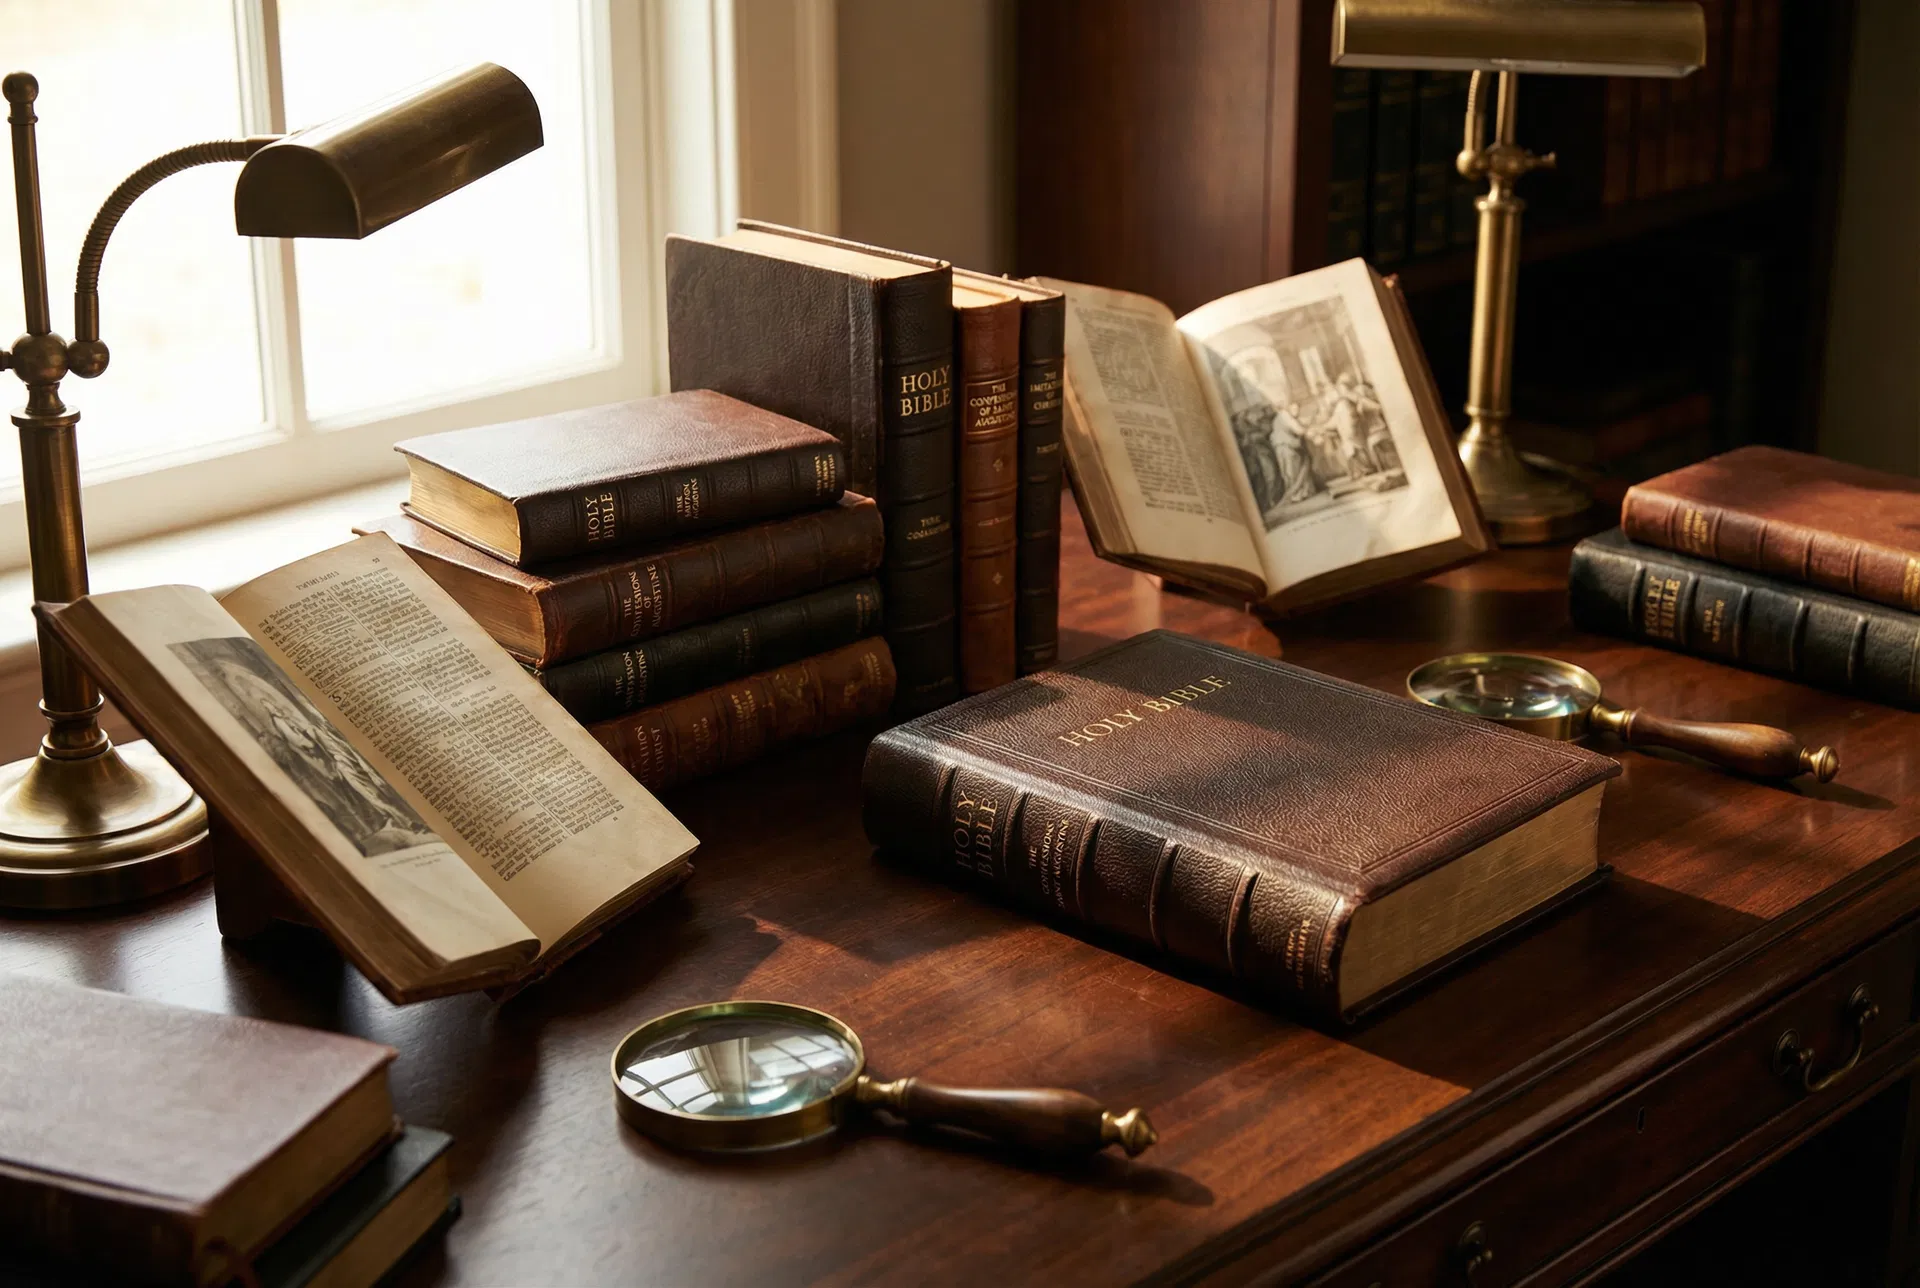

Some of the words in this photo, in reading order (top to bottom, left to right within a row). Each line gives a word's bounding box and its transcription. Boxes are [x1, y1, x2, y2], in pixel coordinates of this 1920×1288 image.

[900, 387, 950, 417] BIBLE
[901, 365, 950, 393] HOLY
[585, 495, 600, 543] HOLY
[600, 492, 616, 540] BIBLE
[623, 597, 632, 618] THE
[643, 595, 652, 609] OF
[1058, 708, 1146, 748] HOLY
[1143, 674, 1232, 714] BIBLE
[953, 790, 977, 869] HOLY
[976, 798, 998, 878] BIBLE
